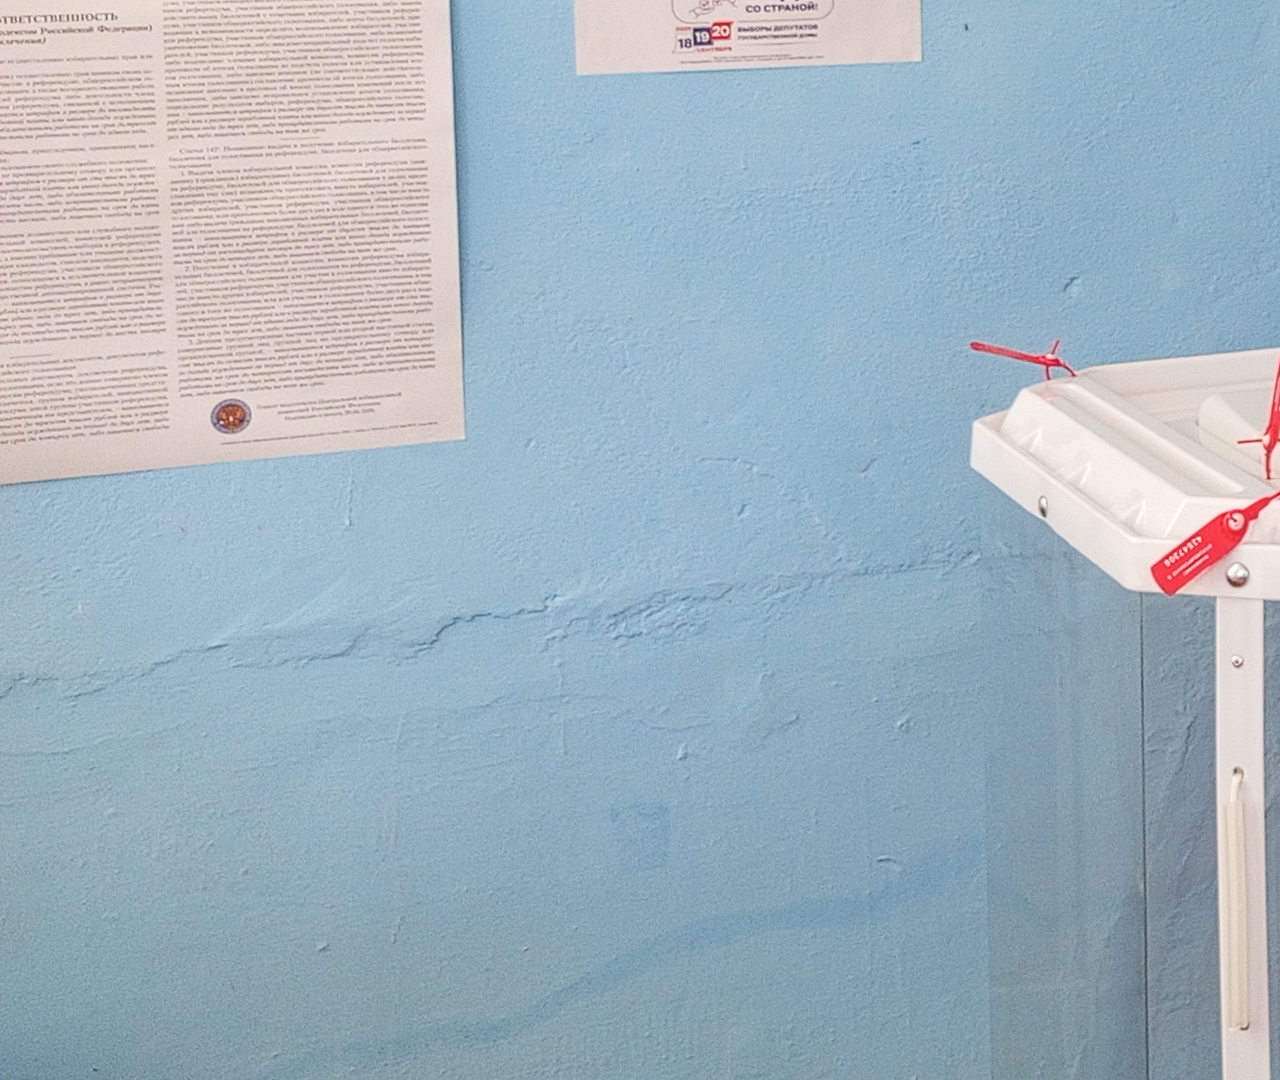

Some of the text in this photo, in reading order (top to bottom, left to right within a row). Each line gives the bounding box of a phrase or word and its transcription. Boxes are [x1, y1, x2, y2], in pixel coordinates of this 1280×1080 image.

[746, 1, 819, 14] СО СТРАНОЙ!
[711, 25, 731, 39] 20
[677, 38, 693, 51] 18
[694, 30, 711, 44] 19
